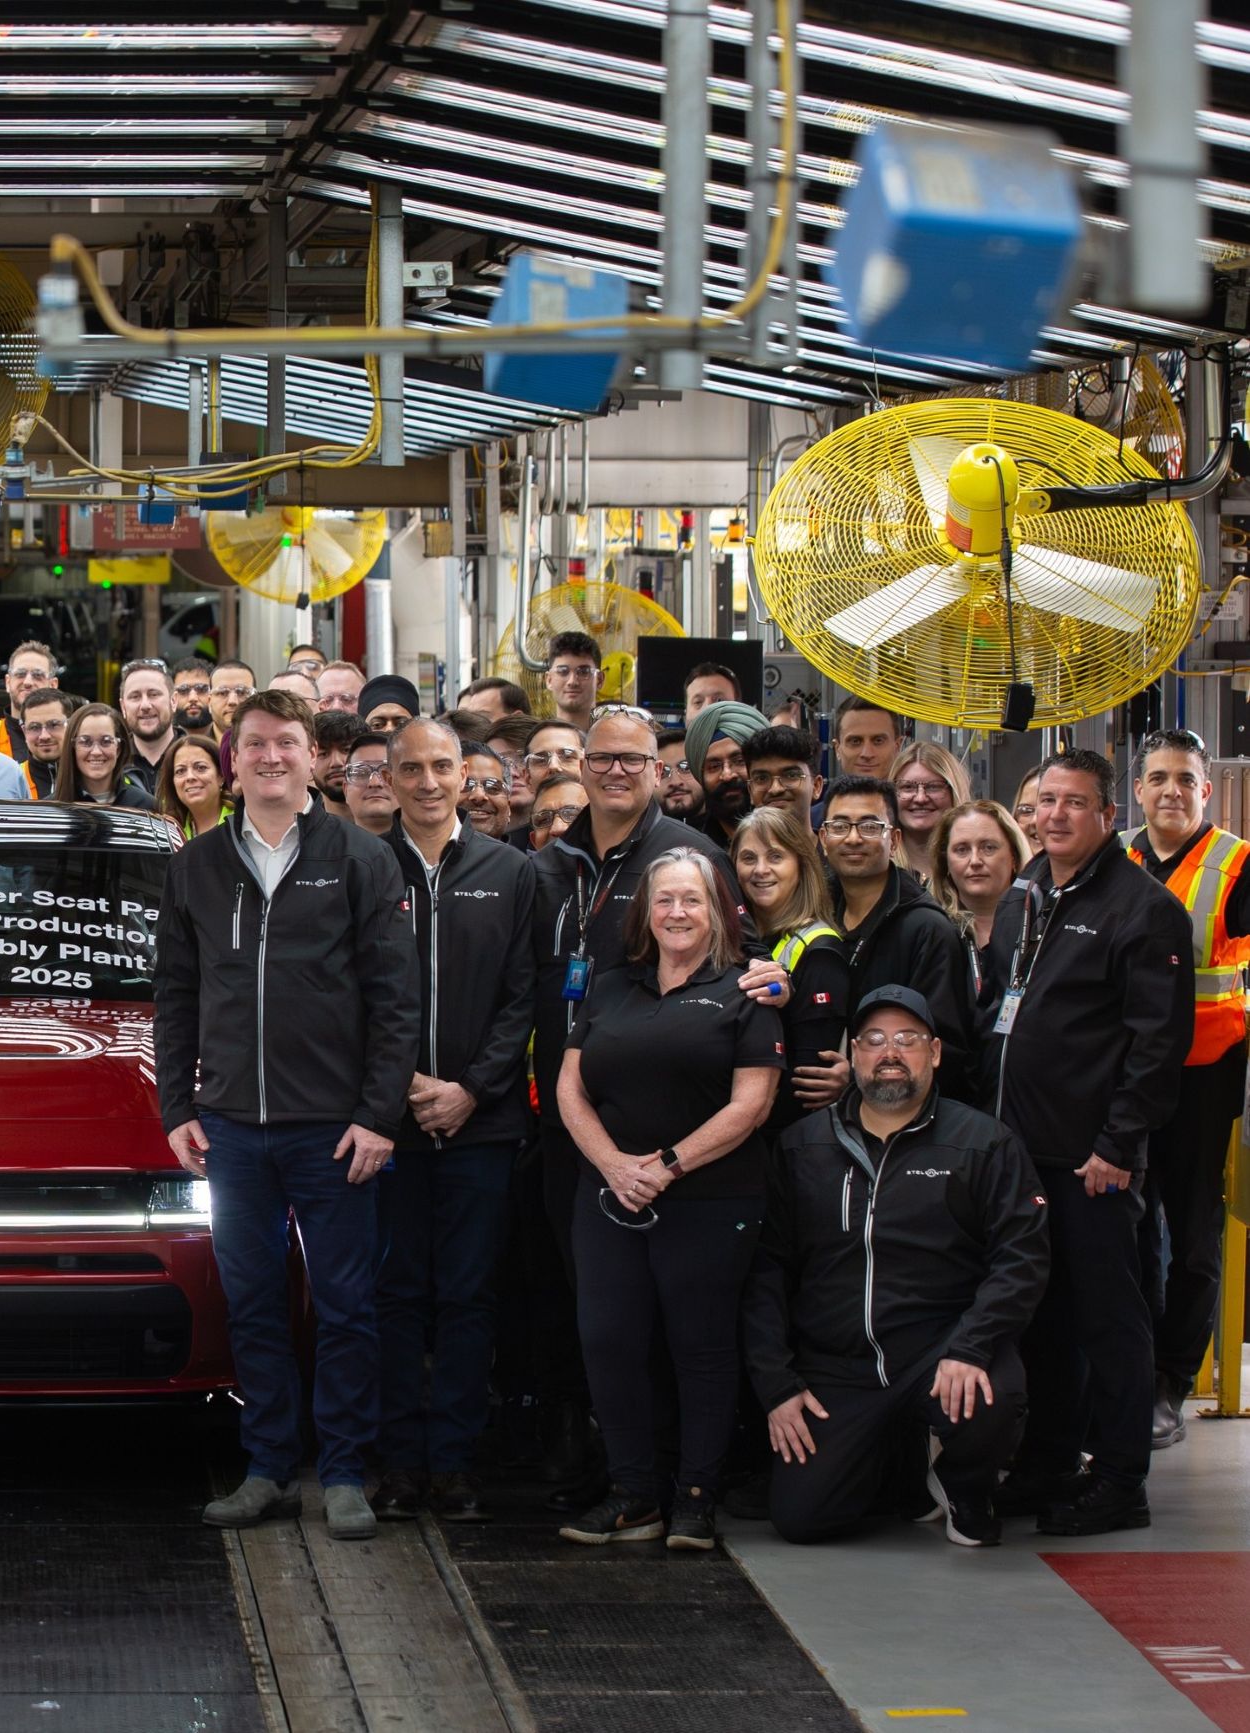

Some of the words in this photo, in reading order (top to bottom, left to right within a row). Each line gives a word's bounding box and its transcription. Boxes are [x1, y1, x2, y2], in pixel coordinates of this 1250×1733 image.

[32, 890, 110, 913] Scat
[121, 900, 160, 920] Pa
[454, 890, 499, 898] STELLANTIS
[59, 943, 147, 970] Plant
[10, 966, 93, 989] 2025
